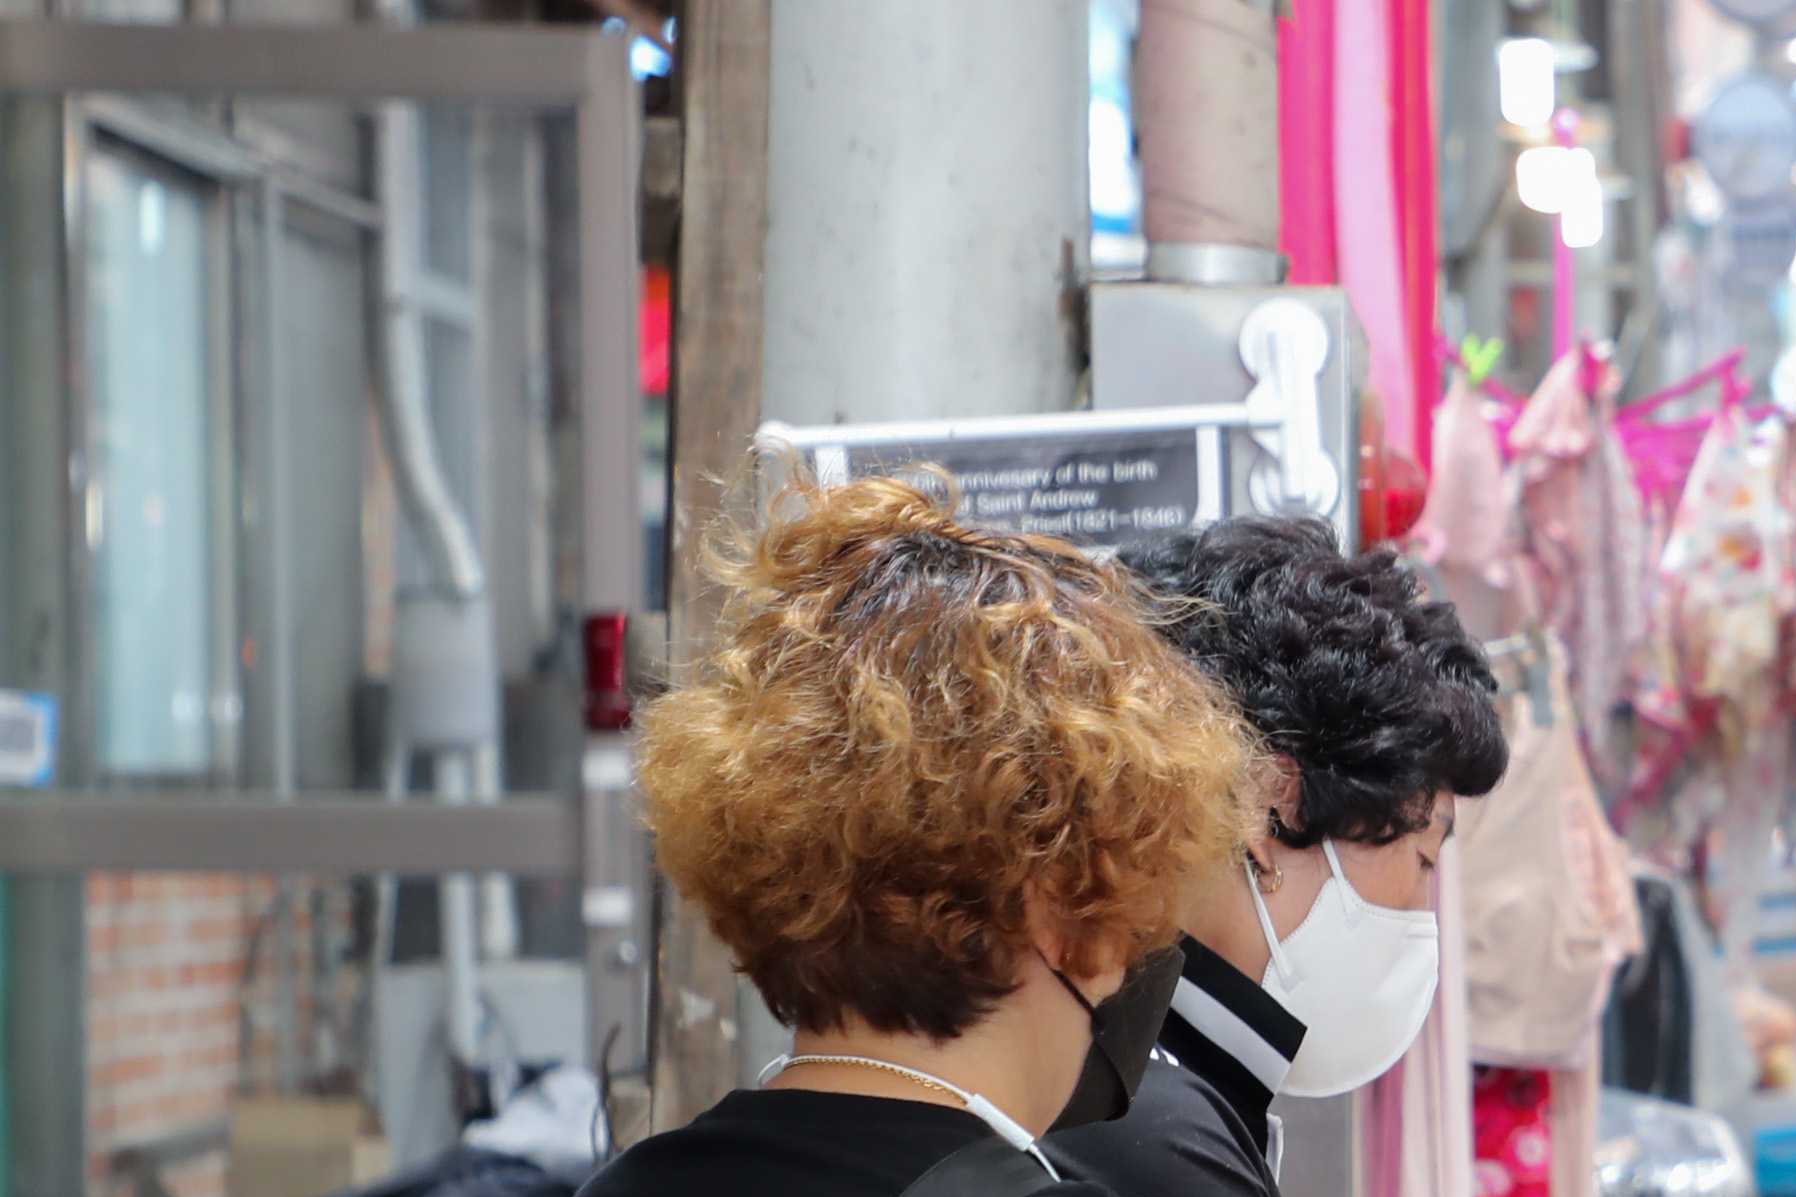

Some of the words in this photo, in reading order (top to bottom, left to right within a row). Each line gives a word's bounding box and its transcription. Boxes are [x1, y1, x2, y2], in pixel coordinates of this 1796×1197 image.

[1056, 463, 1075, 485] of
[1078, 462, 1110, 484] the
[1113, 460, 1158, 482] birth
[977, 492, 1026, 514] Saint
[1030, 489, 1097, 511] Andrew
